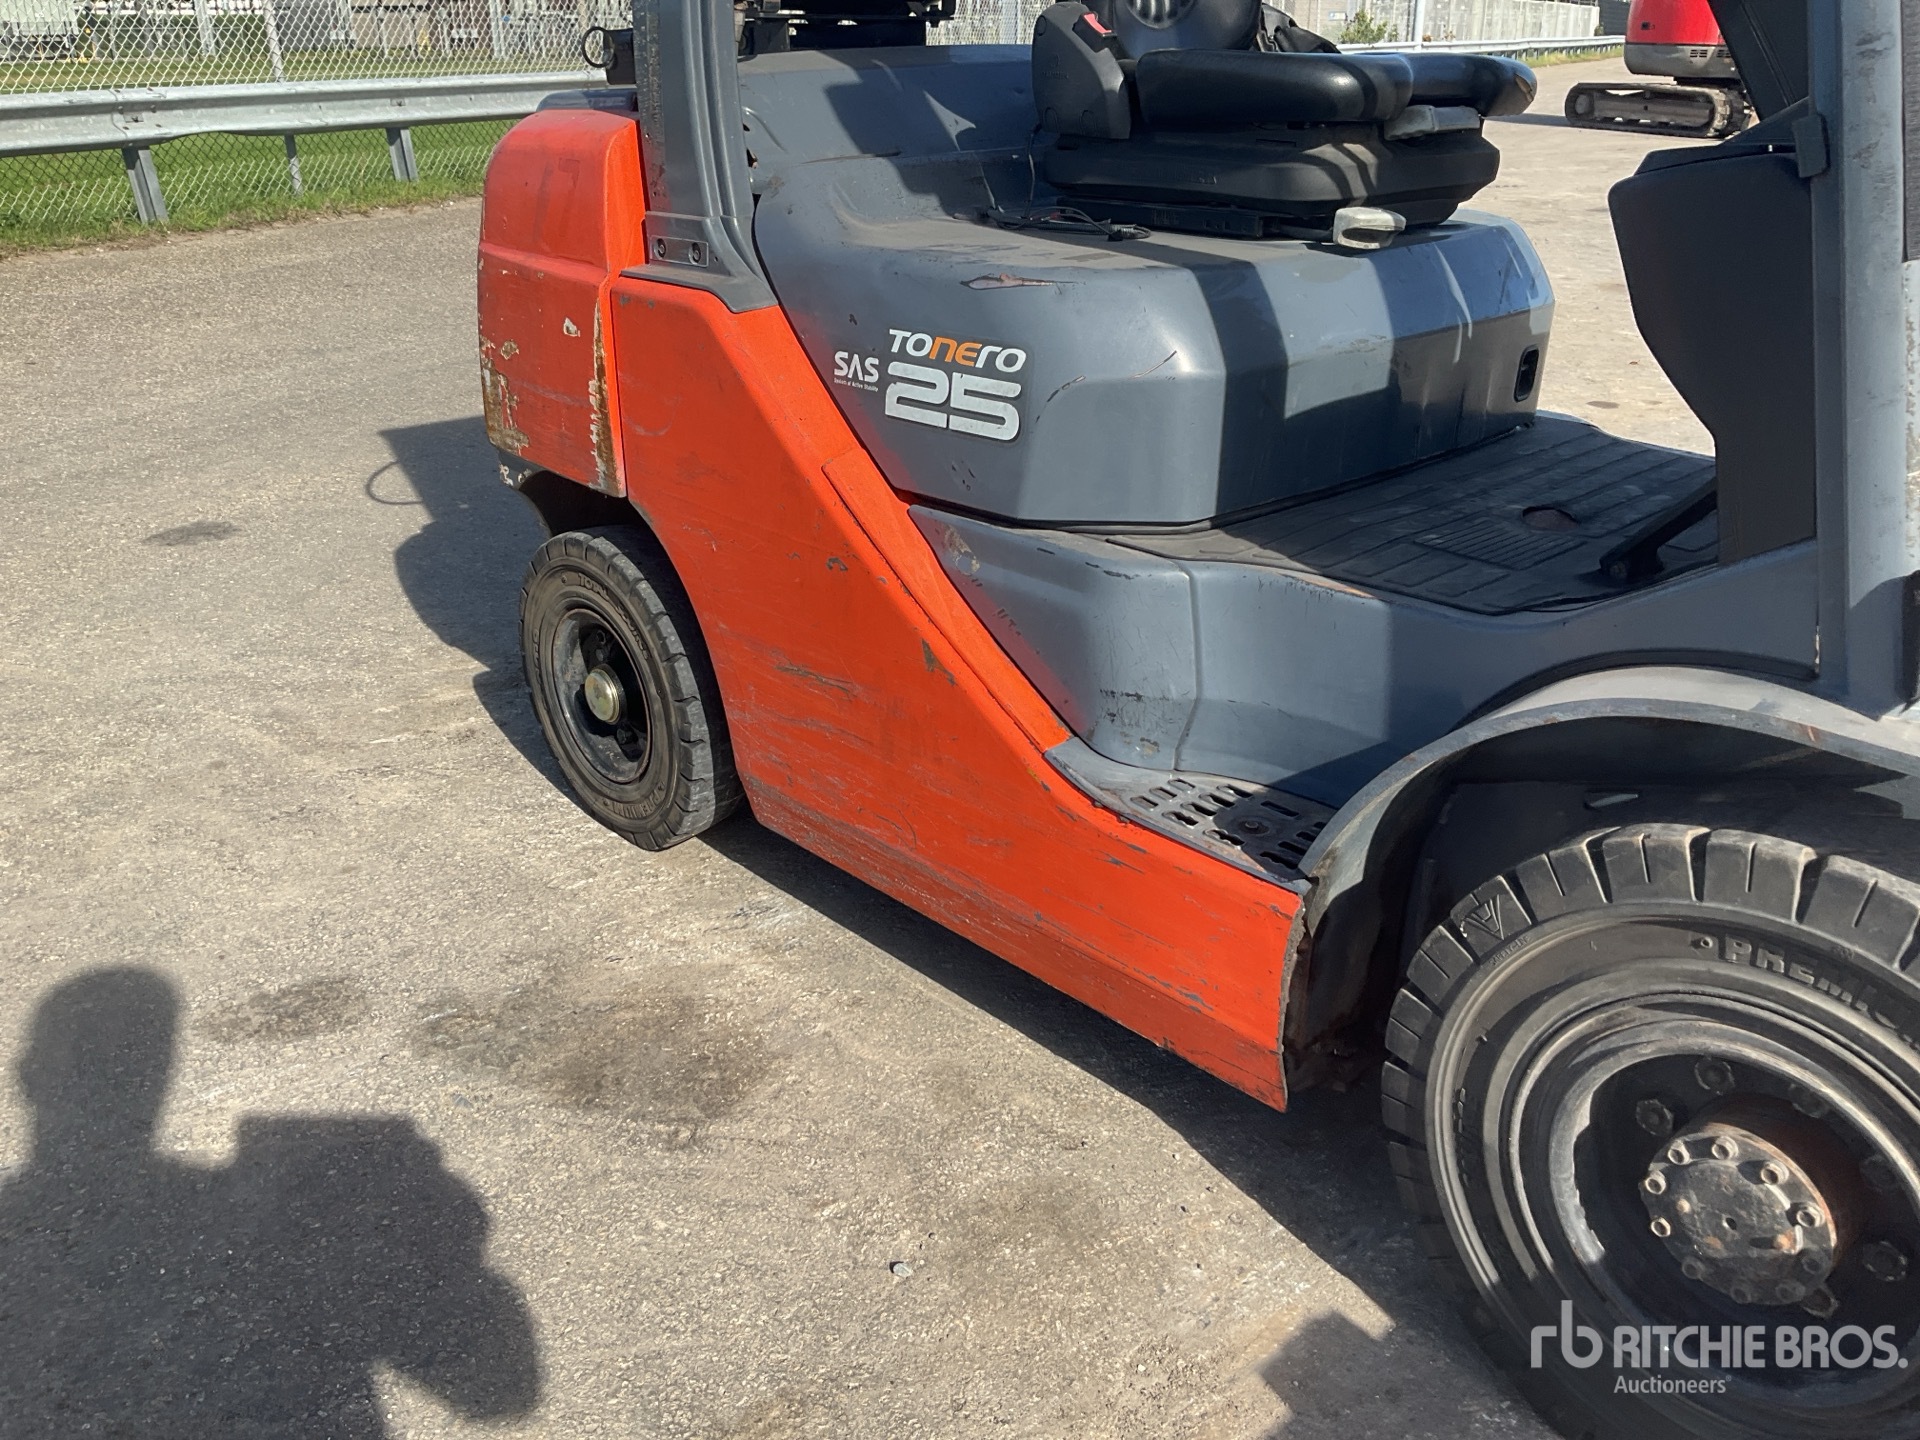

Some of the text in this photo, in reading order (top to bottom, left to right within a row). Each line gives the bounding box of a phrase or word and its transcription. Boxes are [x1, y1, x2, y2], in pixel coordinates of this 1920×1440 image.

[834, 350, 879, 383] SAS
[889, 328, 1027, 373] TONERO
[885, 361, 1022, 441] 25
